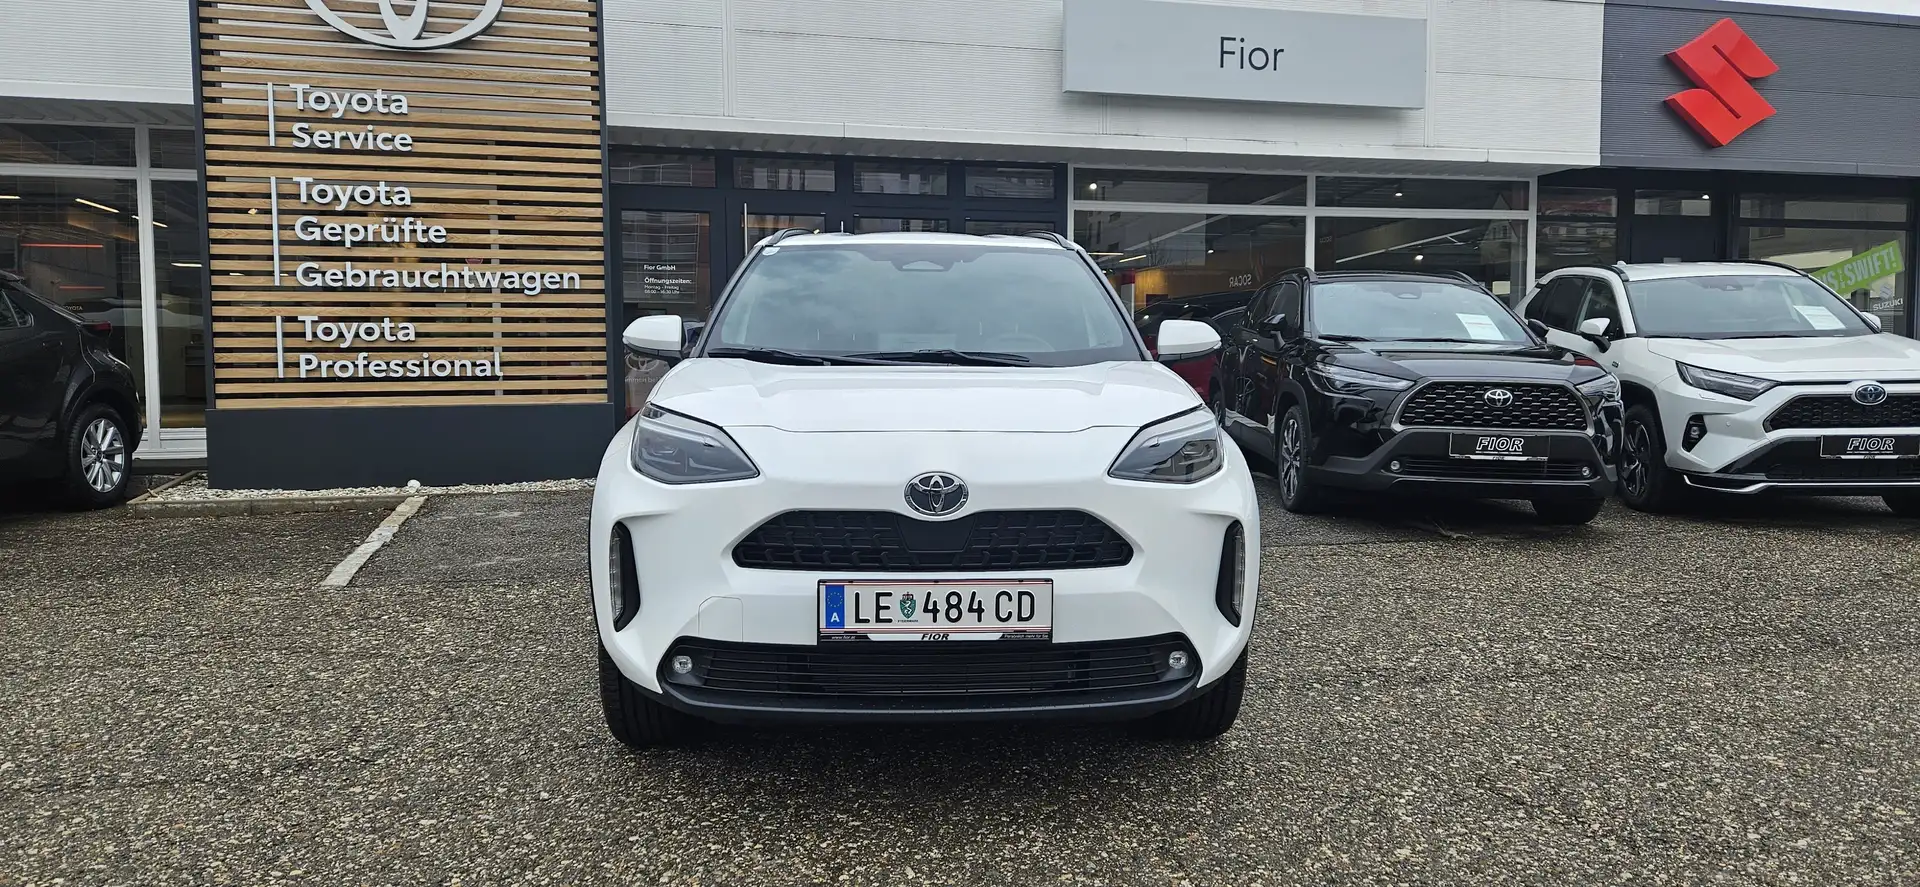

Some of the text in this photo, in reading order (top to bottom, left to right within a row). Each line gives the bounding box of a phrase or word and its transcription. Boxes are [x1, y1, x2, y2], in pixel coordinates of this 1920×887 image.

[1219, 36, 1285, 71] Fior
[289, 83, 408, 118] Toyota
[292, 122, 413, 151] Service
[292, 176, 412, 211] Toyota
[294, 215, 447, 248] Geprüfte
[295, 261, 581, 295] Gebrauchtwagen
[644, 276, 692, 284] Öffnungszeiten:
[1844, 246, 1897, 286] SWIFT!
[1872, 298, 1904, 311] SUZUKI
[298, 315, 416, 348] Toyota
[299, 351, 503, 378] Professional
[1476, 437, 1524, 451] FIOR
[1847, 438, 1895, 451] FIOR
[830, 612, 840, 622] A
[855, 590, 1035, 623] LE 484 CD
